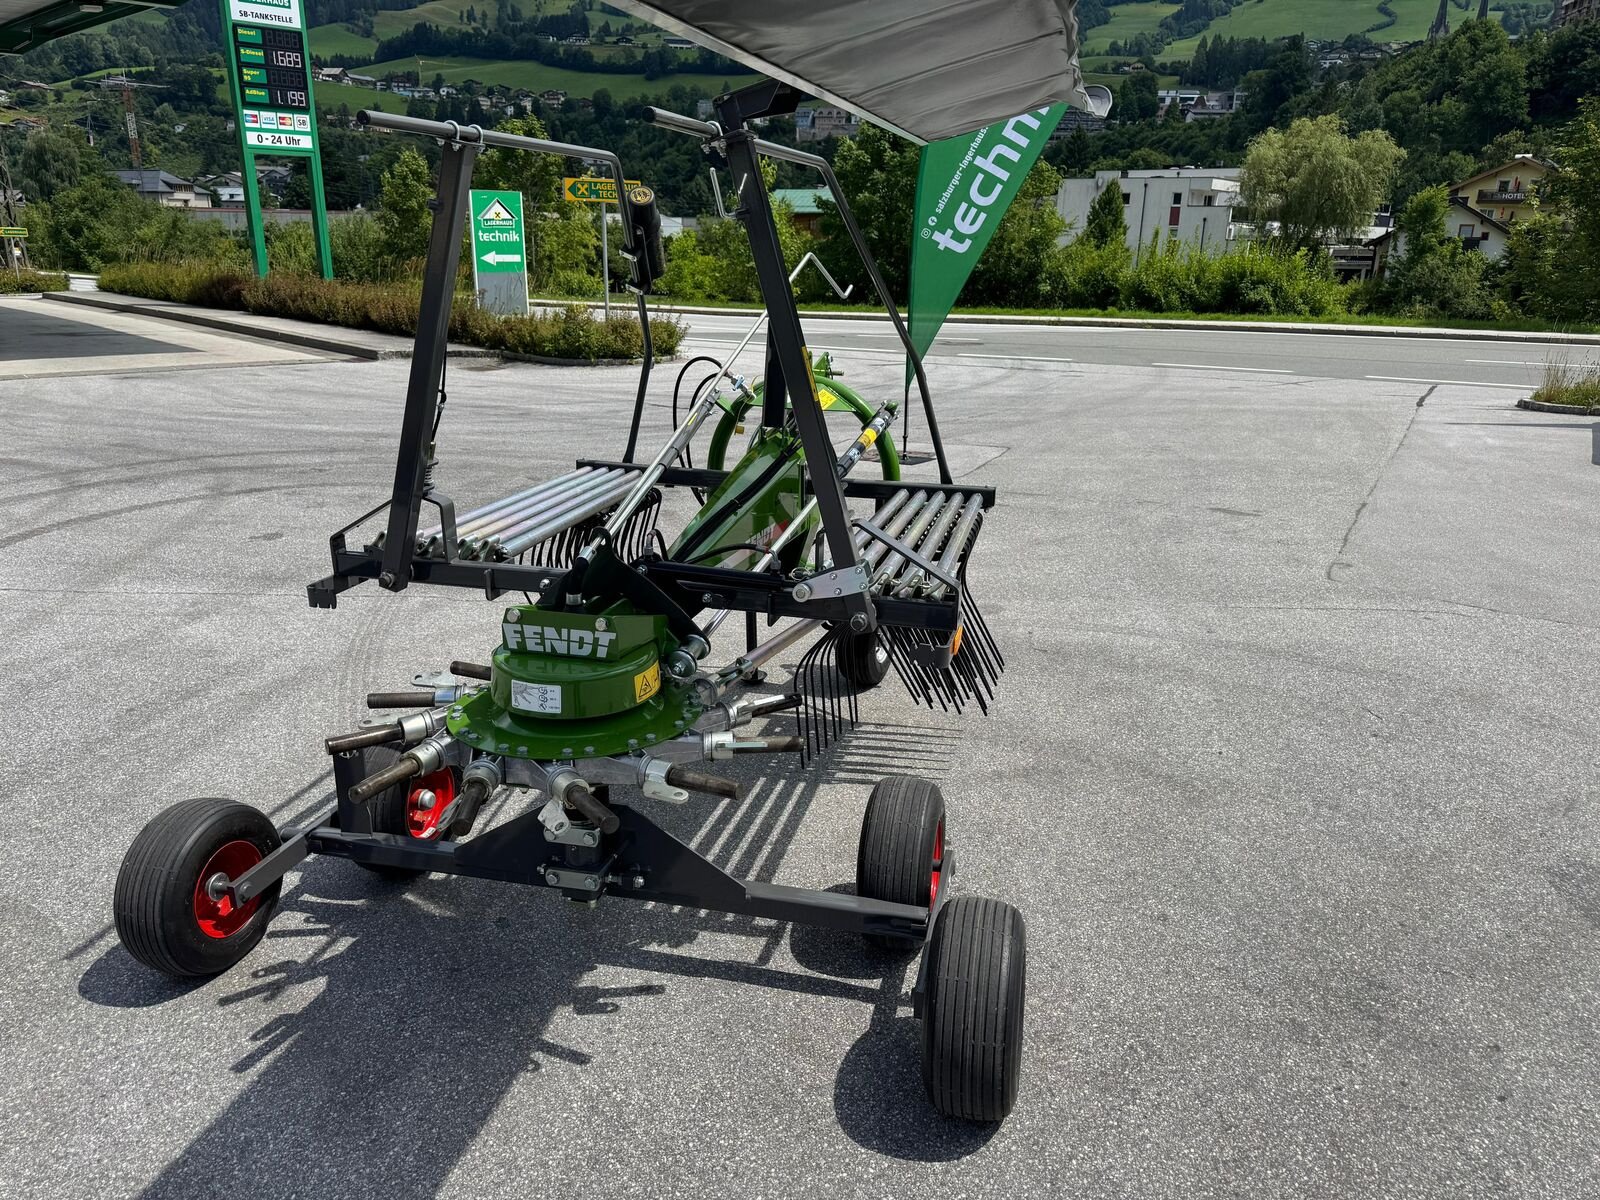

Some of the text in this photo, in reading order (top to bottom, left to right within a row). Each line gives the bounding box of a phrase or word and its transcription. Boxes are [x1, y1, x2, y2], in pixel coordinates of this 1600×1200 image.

[238, 9, 294, 24] SB-TANKSTELLE
[237, 28, 256, 36] Diesel
[240, 49, 264, 57] S-Diesel
[272, 50, 302, 68] 1.689
[242, 68, 260, 76] Super
[245, 88, 266, 96] AdBlue
[277, 90, 306, 106] 1.199
[297, 118, 307, 127] SB
[257, 134, 264, 144] 0
[271, 135, 283, 145] 24
[285, 135, 301, 146] Uhr
[591, 182, 638, 192] LAGERAU
[478, 229, 520, 242] technik
[502, 622, 617, 659] FENDT
